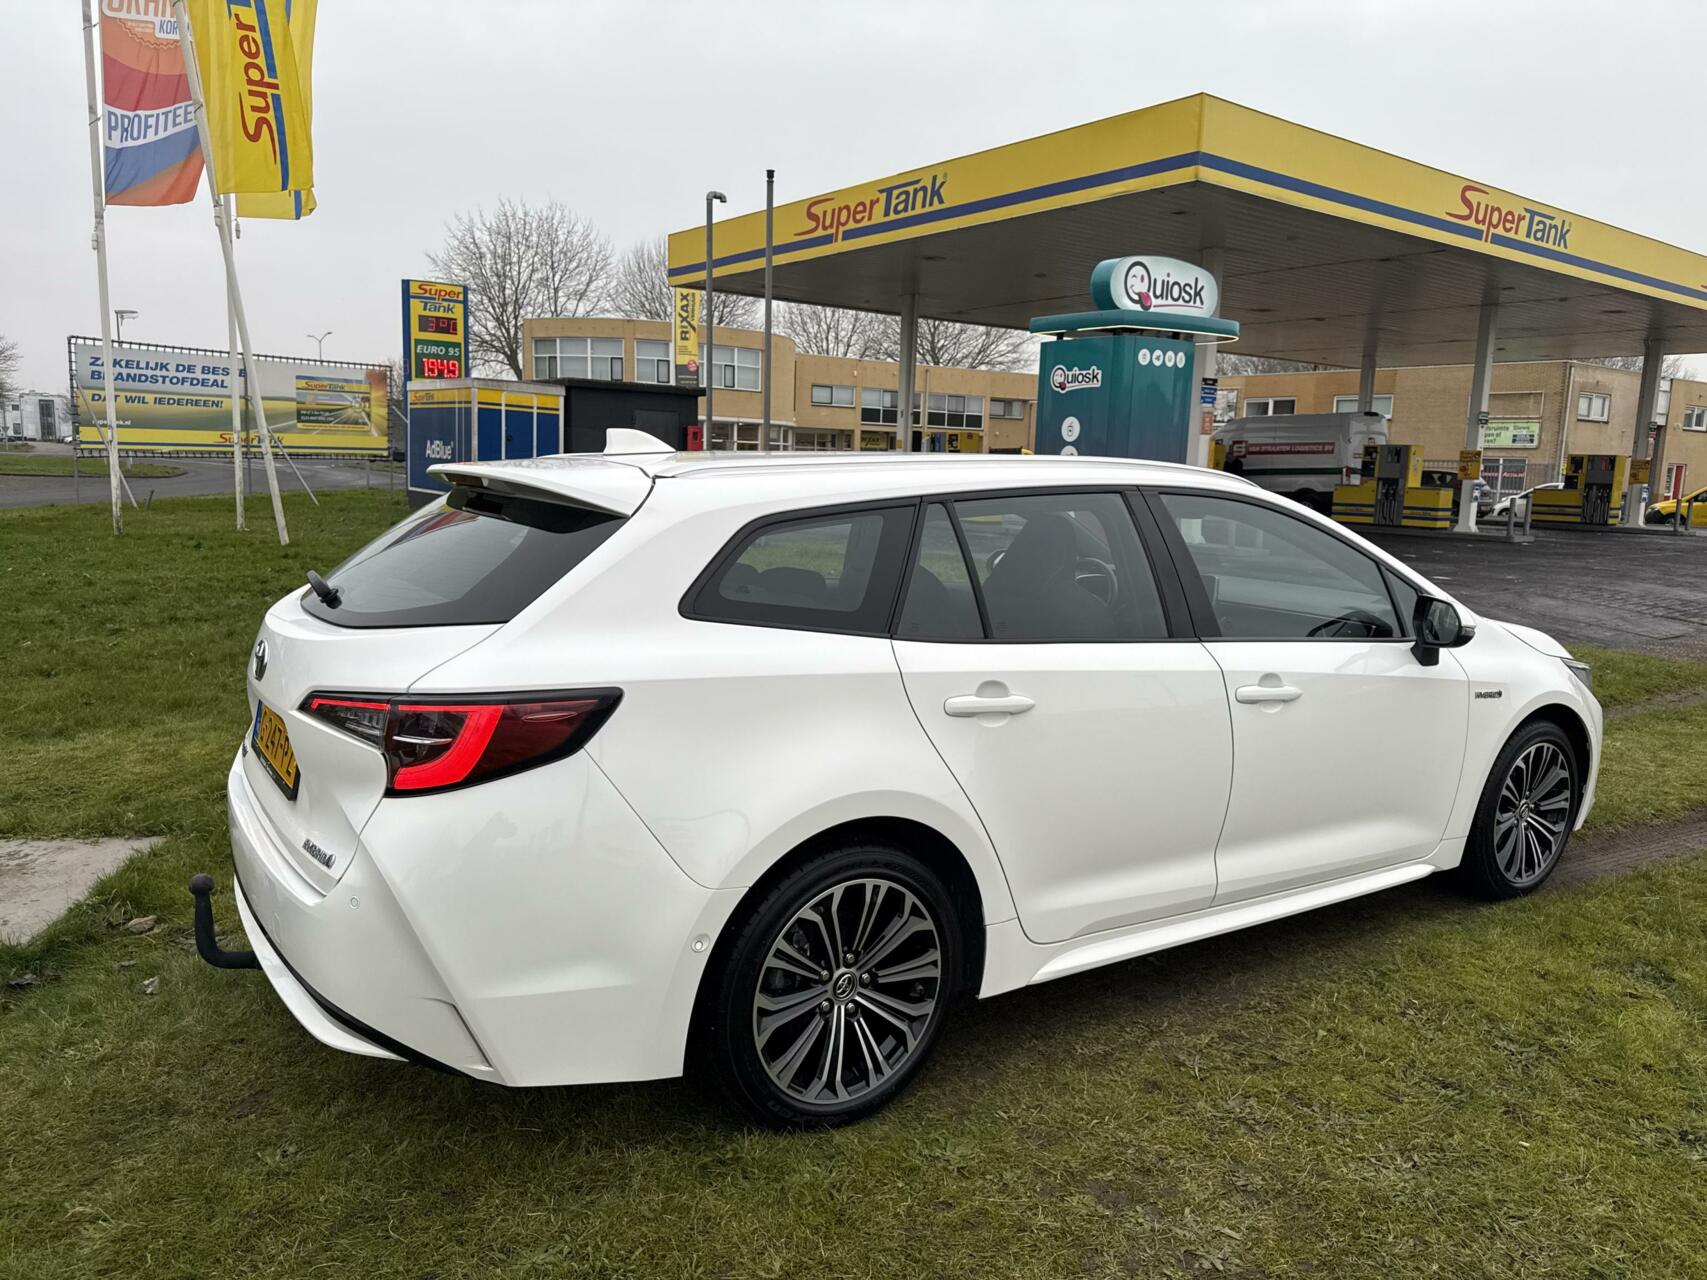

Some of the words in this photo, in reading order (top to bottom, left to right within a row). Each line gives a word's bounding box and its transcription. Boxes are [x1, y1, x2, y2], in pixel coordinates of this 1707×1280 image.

[107, 104, 195, 143] PROFITEE
[794, 174, 947, 242] SuperTank
[1445, 185, 1570, 249] SuperTank
[411, 284, 462, 301] Super
[1124, 261, 1204, 311] Quiosk
[421, 301, 455, 314] Tank
[678, 292, 696, 341] RIXAX
[417, 344, 446, 355] EURO
[447, 347, 460, 356] 95
[89, 356, 170, 372] ZKELIJK
[175, 363, 196, 373] DE
[201, 365, 246, 378] BESE
[90, 370, 228, 389] BANDSTOFDEAL
[1052, 367, 1100, 391] Quiosk
[124, 395, 149, 404] WIL
[153, 397, 223, 408] IEDEREEN!
